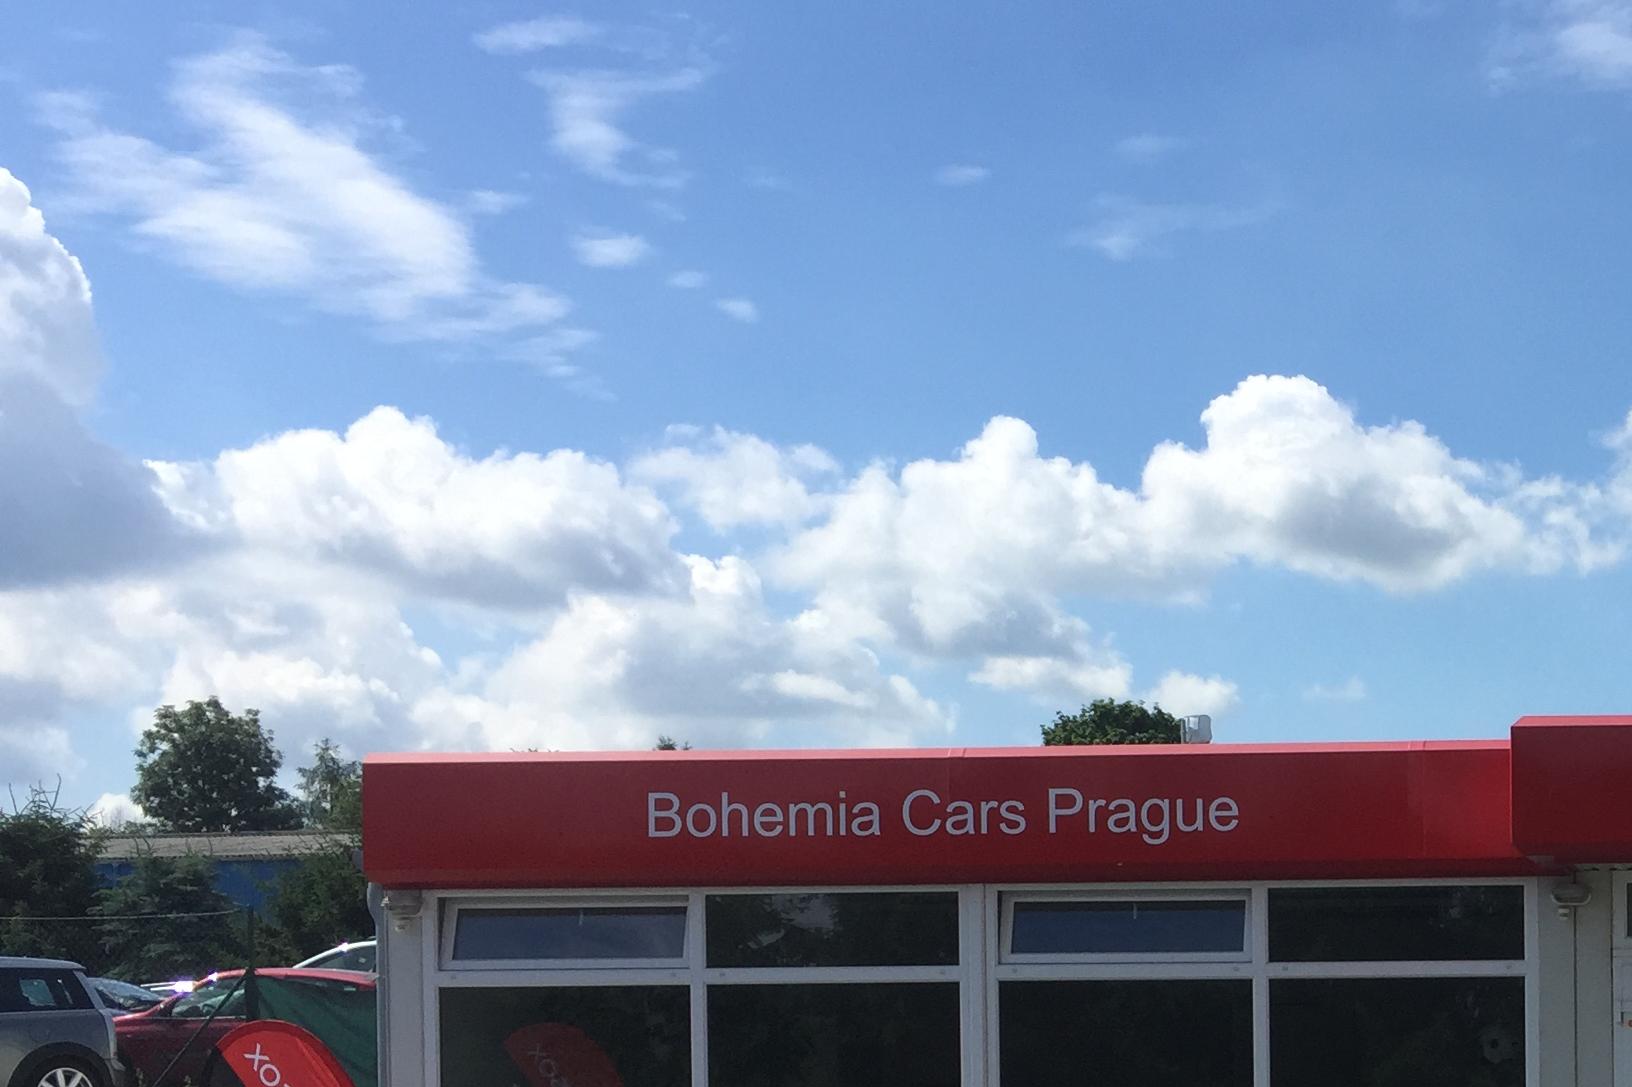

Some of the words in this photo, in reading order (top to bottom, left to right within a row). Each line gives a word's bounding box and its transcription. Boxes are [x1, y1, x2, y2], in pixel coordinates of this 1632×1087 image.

[647, 791, 881, 838] Bohemia
[902, 789, 1026, 836] Cars
[1048, 788, 1239, 845] Prague
